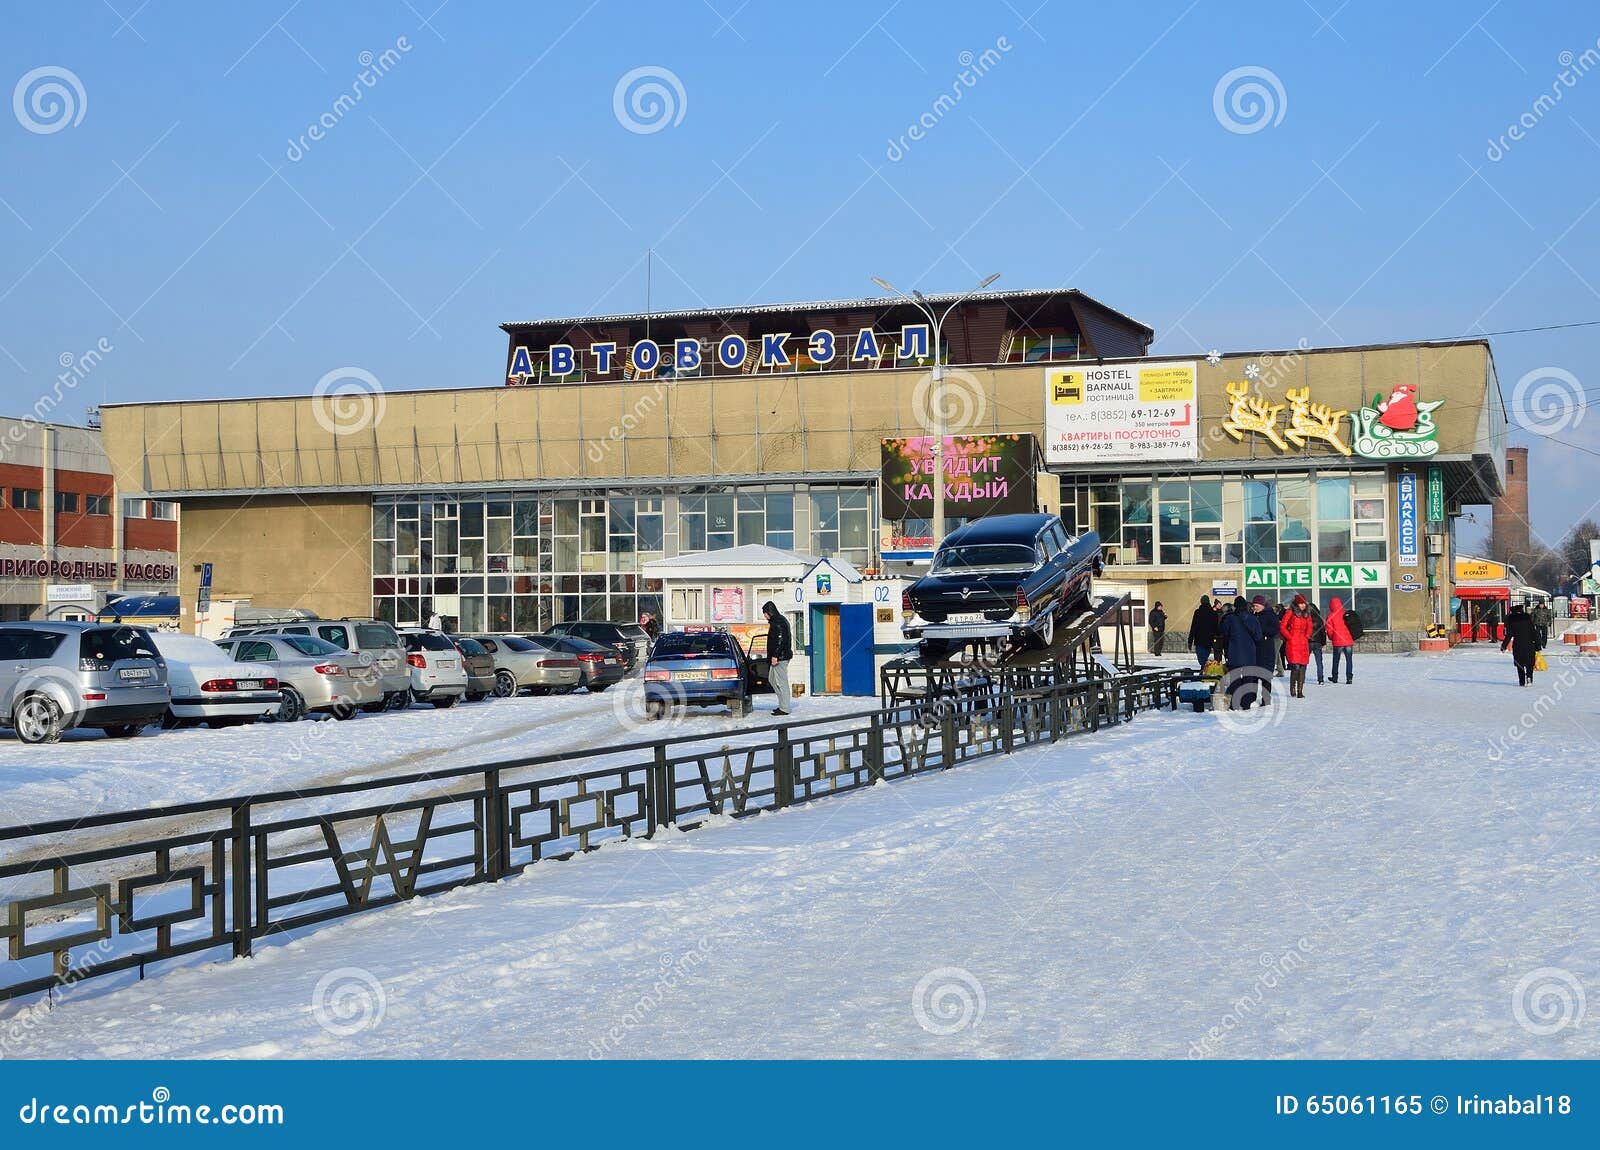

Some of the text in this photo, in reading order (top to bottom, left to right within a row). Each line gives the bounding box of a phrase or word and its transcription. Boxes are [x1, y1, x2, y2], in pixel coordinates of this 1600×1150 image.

[509, 324, 929, 378] АВТОВОКЗАЛ
[1086, 370, 1132, 381] HOSTEL
[1086, 382, 1134, 392] BARNAUL
[1086, 393, 1134, 402] гостиница
[1090, 409, 1127, 422] 8(3852)
[1130, 408, 1176, 419] 69-12-69
[1061, 429, 1181, 442] КВАРТИРЫ ПОСУТОЧНО
[1052, 443, 1080, 452] 8(3852)
[1129, 440, 1191, 450] 8-983-389-79-69
[910, 456, 1002, 478] УВИДИТ
[1431, 478, 1440, 519] АПТЕКА
[1401, 475, 1414, 553] АВИАКАССЫ
[0, 558, 175, 581] РИГОРОДНЫЕ КАССЫ
[1246, 567, 1350, 585] АПТЕКА
[795, 587, 804, 603] 0
[874, 586, 890, 602] 02
